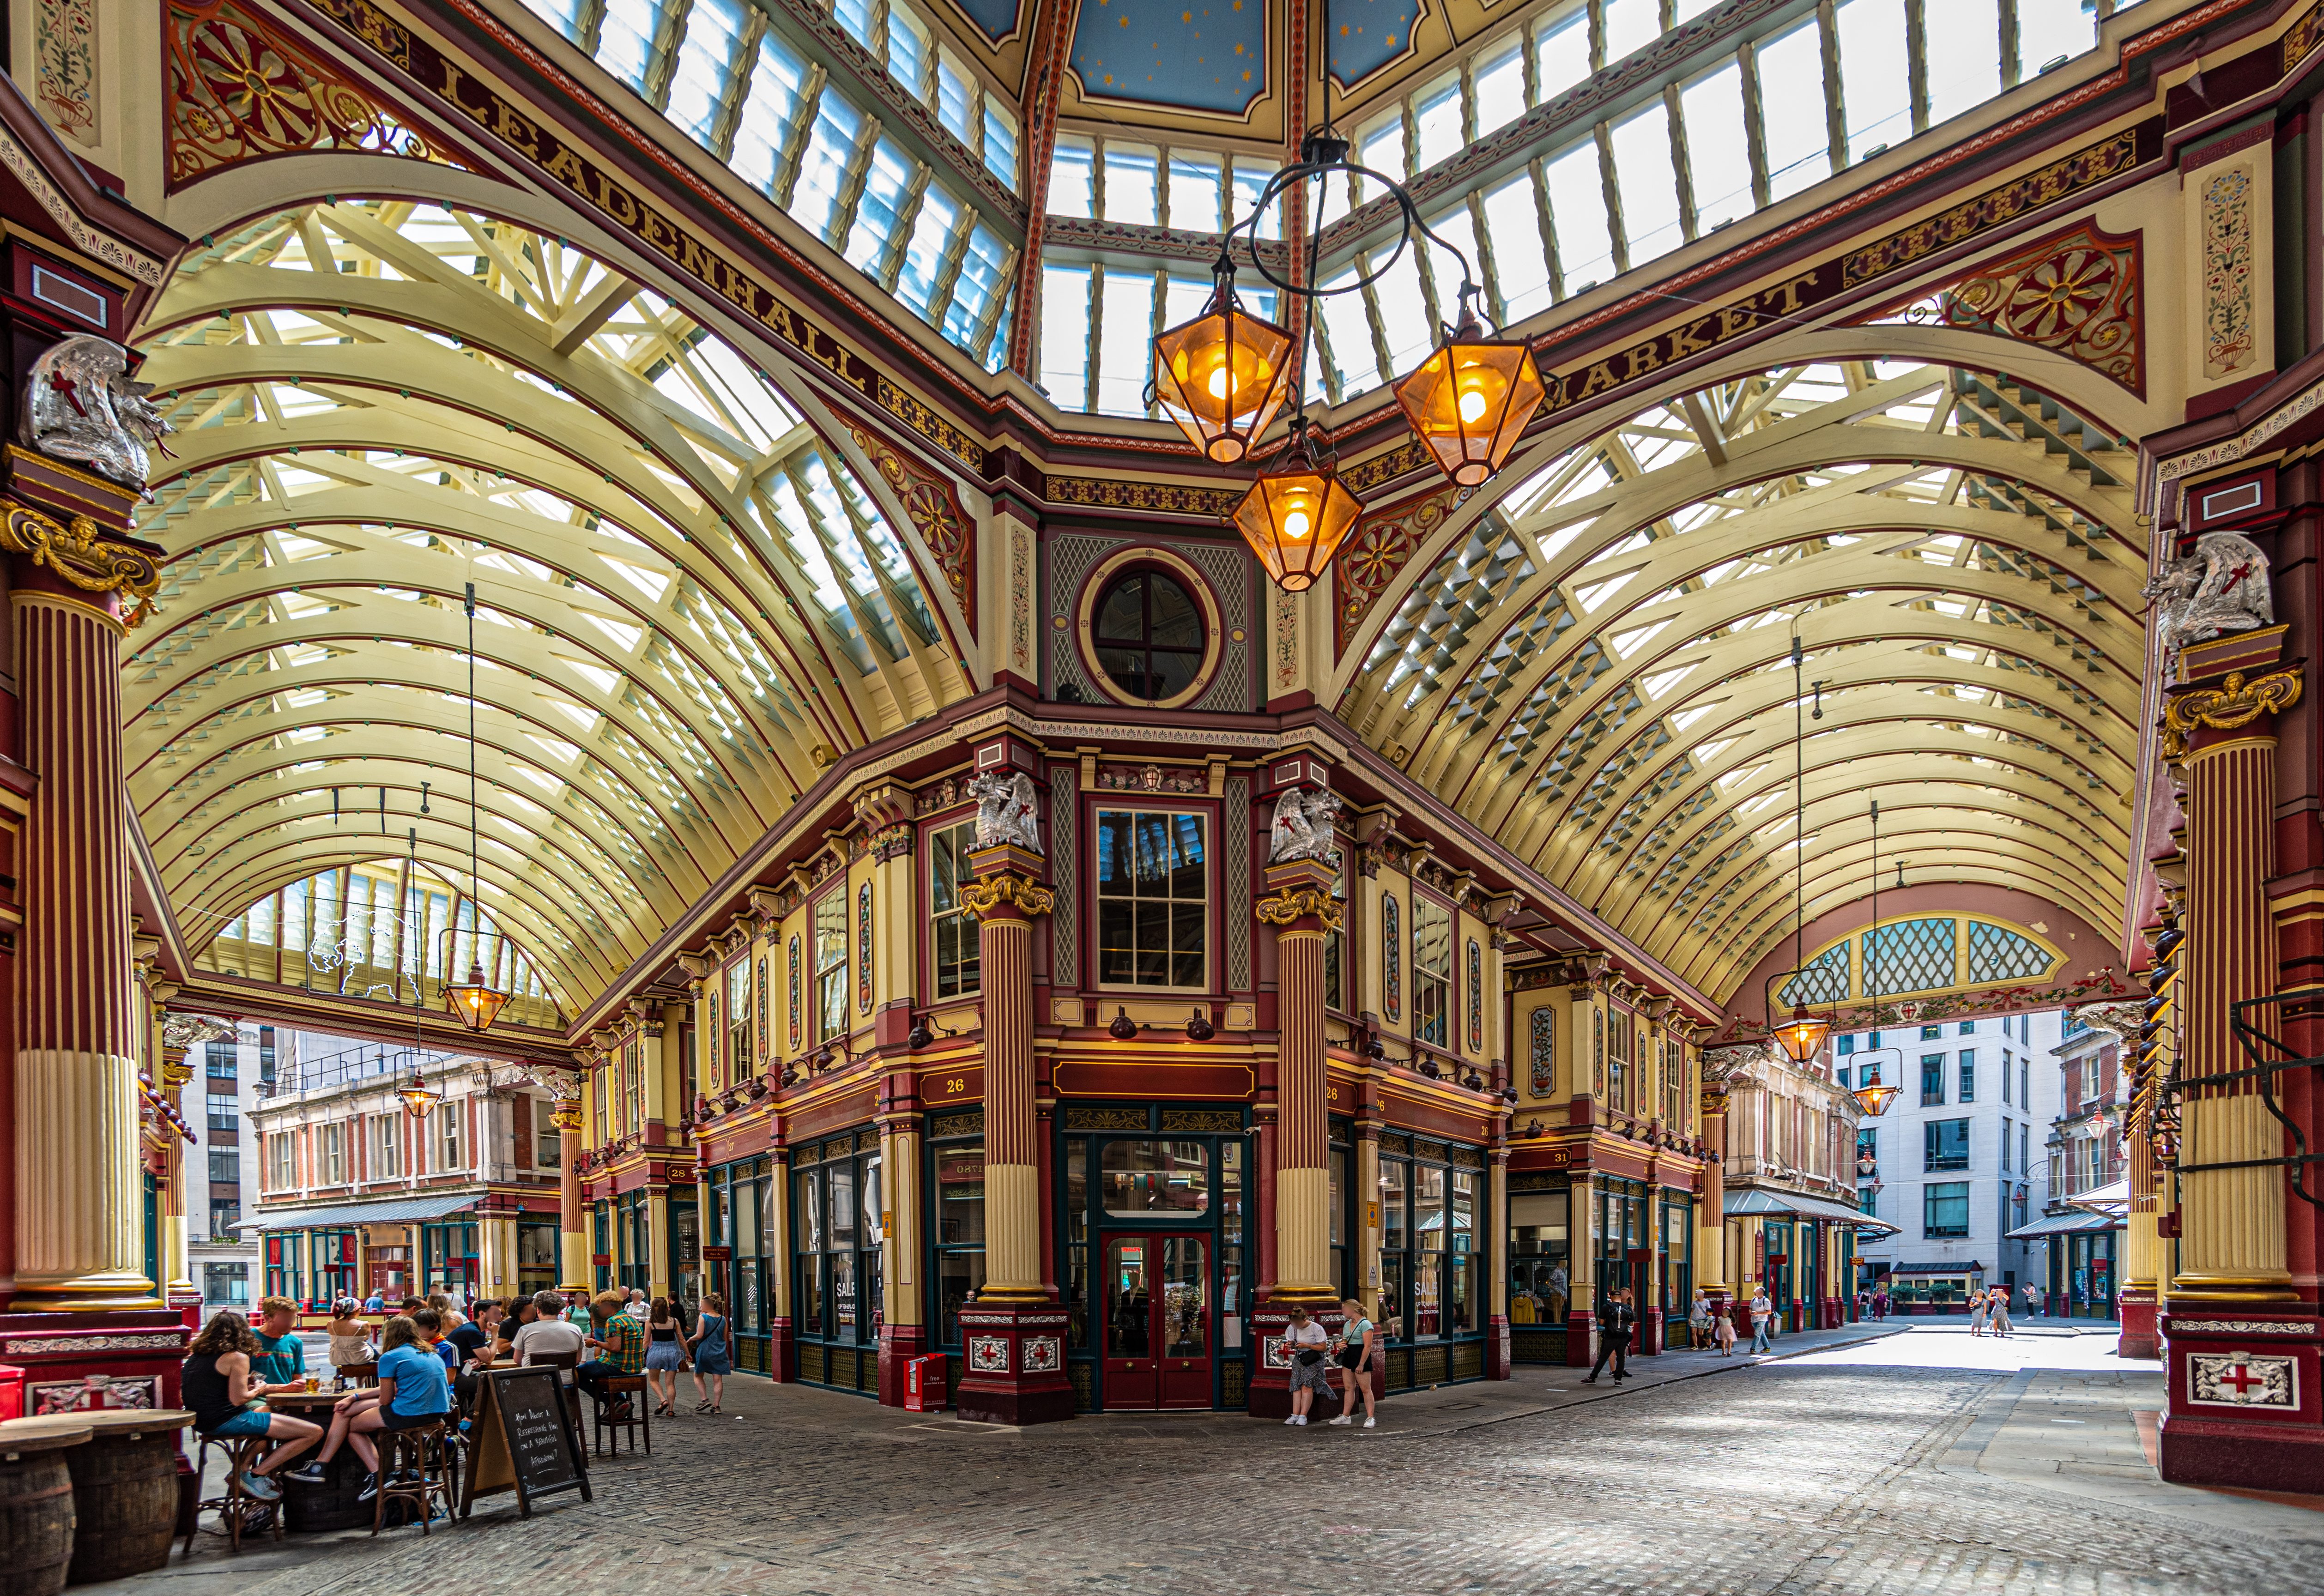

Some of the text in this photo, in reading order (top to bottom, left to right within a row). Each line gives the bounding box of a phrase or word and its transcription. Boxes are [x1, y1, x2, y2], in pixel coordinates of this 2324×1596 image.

[440, 57, 865, 393] LEADENHALL
[1534, 271, 1818, 417] MARKET
[947, 1079, 964, 1093] 26
[1327, 1086, 1338, 1100] 26
[787, 1123, 793, 1134] 26
[1481, 1125, 1488, 1136] 26
[728, 1142, 734, 1151] 27
[1555, 1154, 1566, 1162] 31
[837, 1282, 855, 1297] SALE
[1415, 1282, 1438, 1296] SALE
